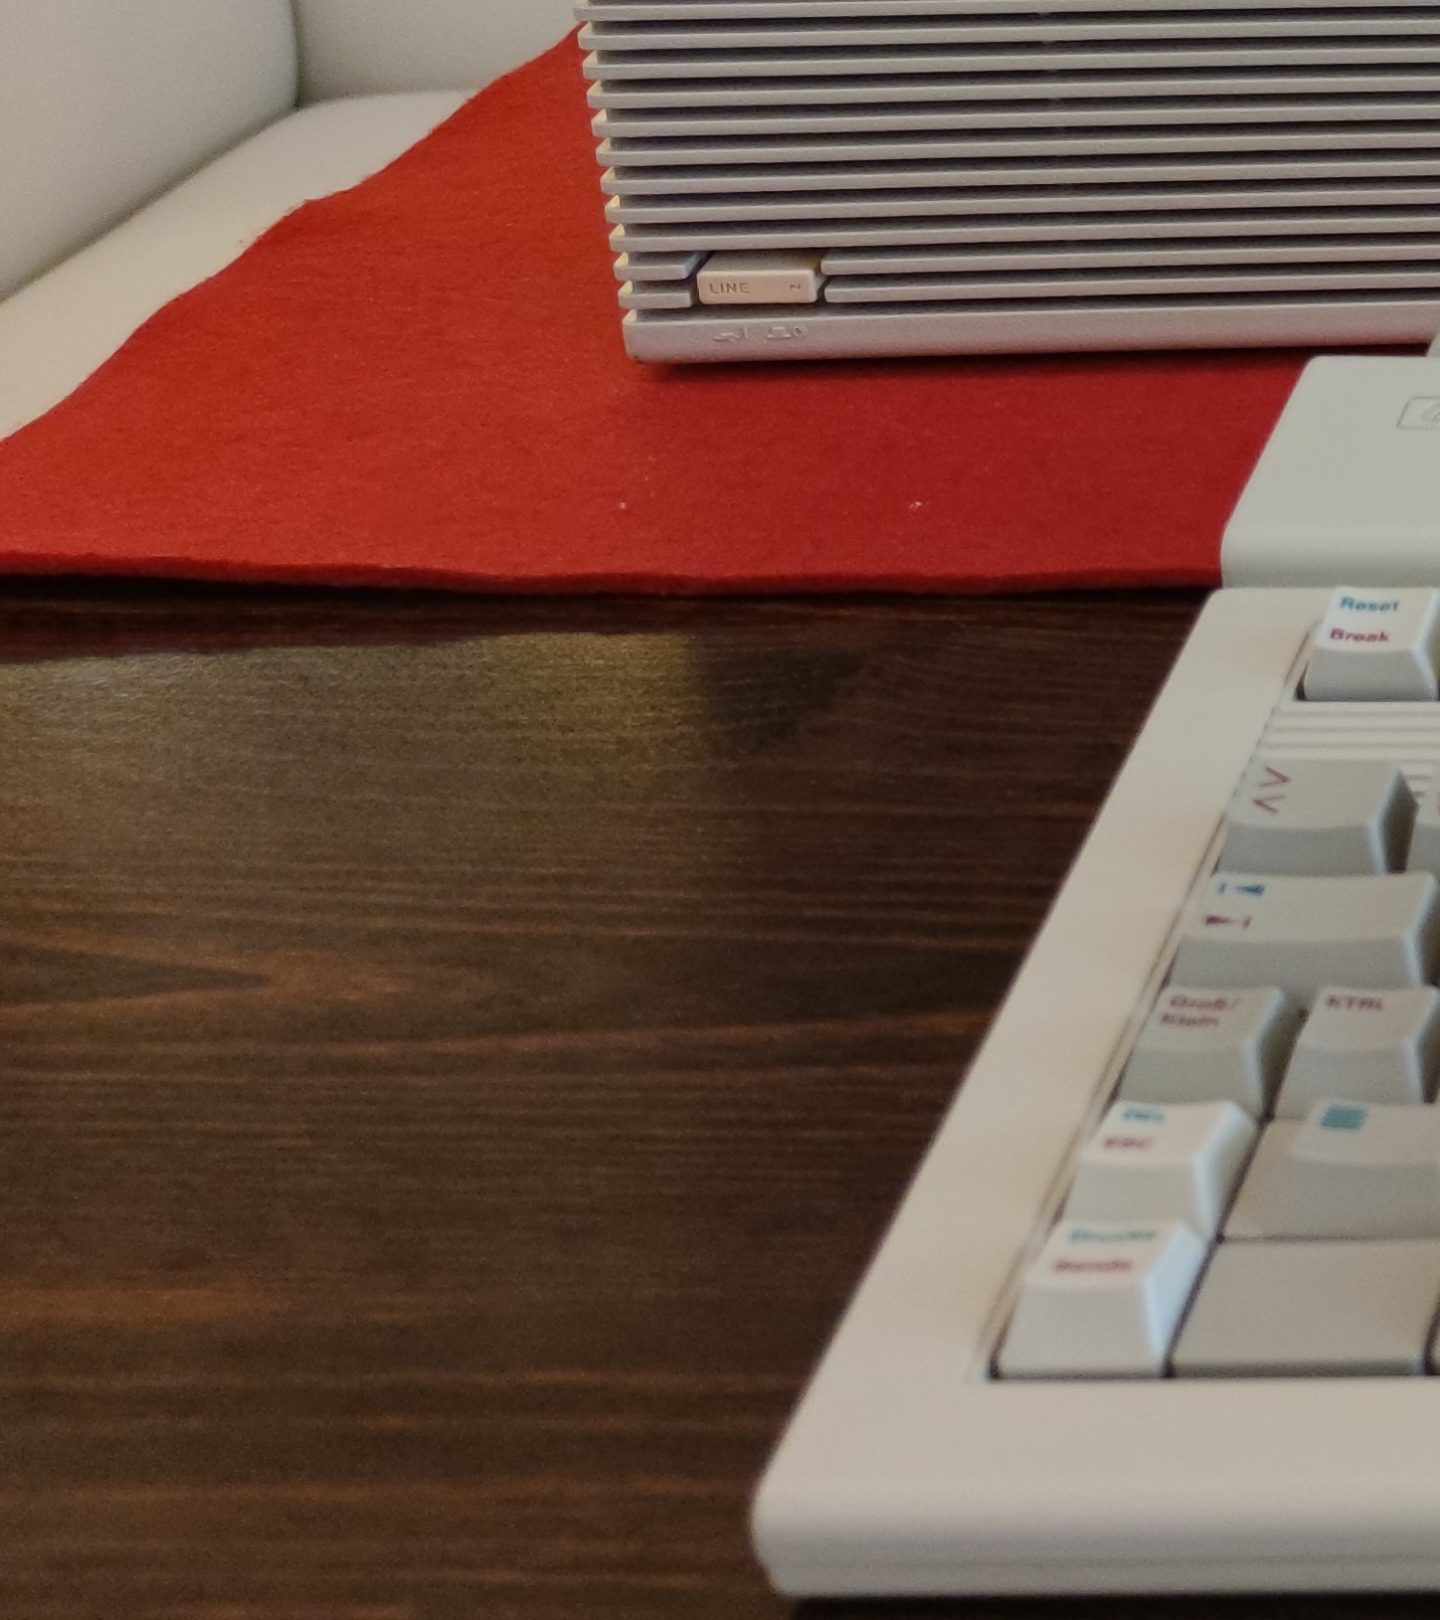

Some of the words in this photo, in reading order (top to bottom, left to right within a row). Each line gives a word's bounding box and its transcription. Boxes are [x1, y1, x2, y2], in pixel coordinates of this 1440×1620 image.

[709, 282, 750, 295] LINE
[1340, 596, 1401, 613] Reset
[1329, 628, 1389, 644] Break
